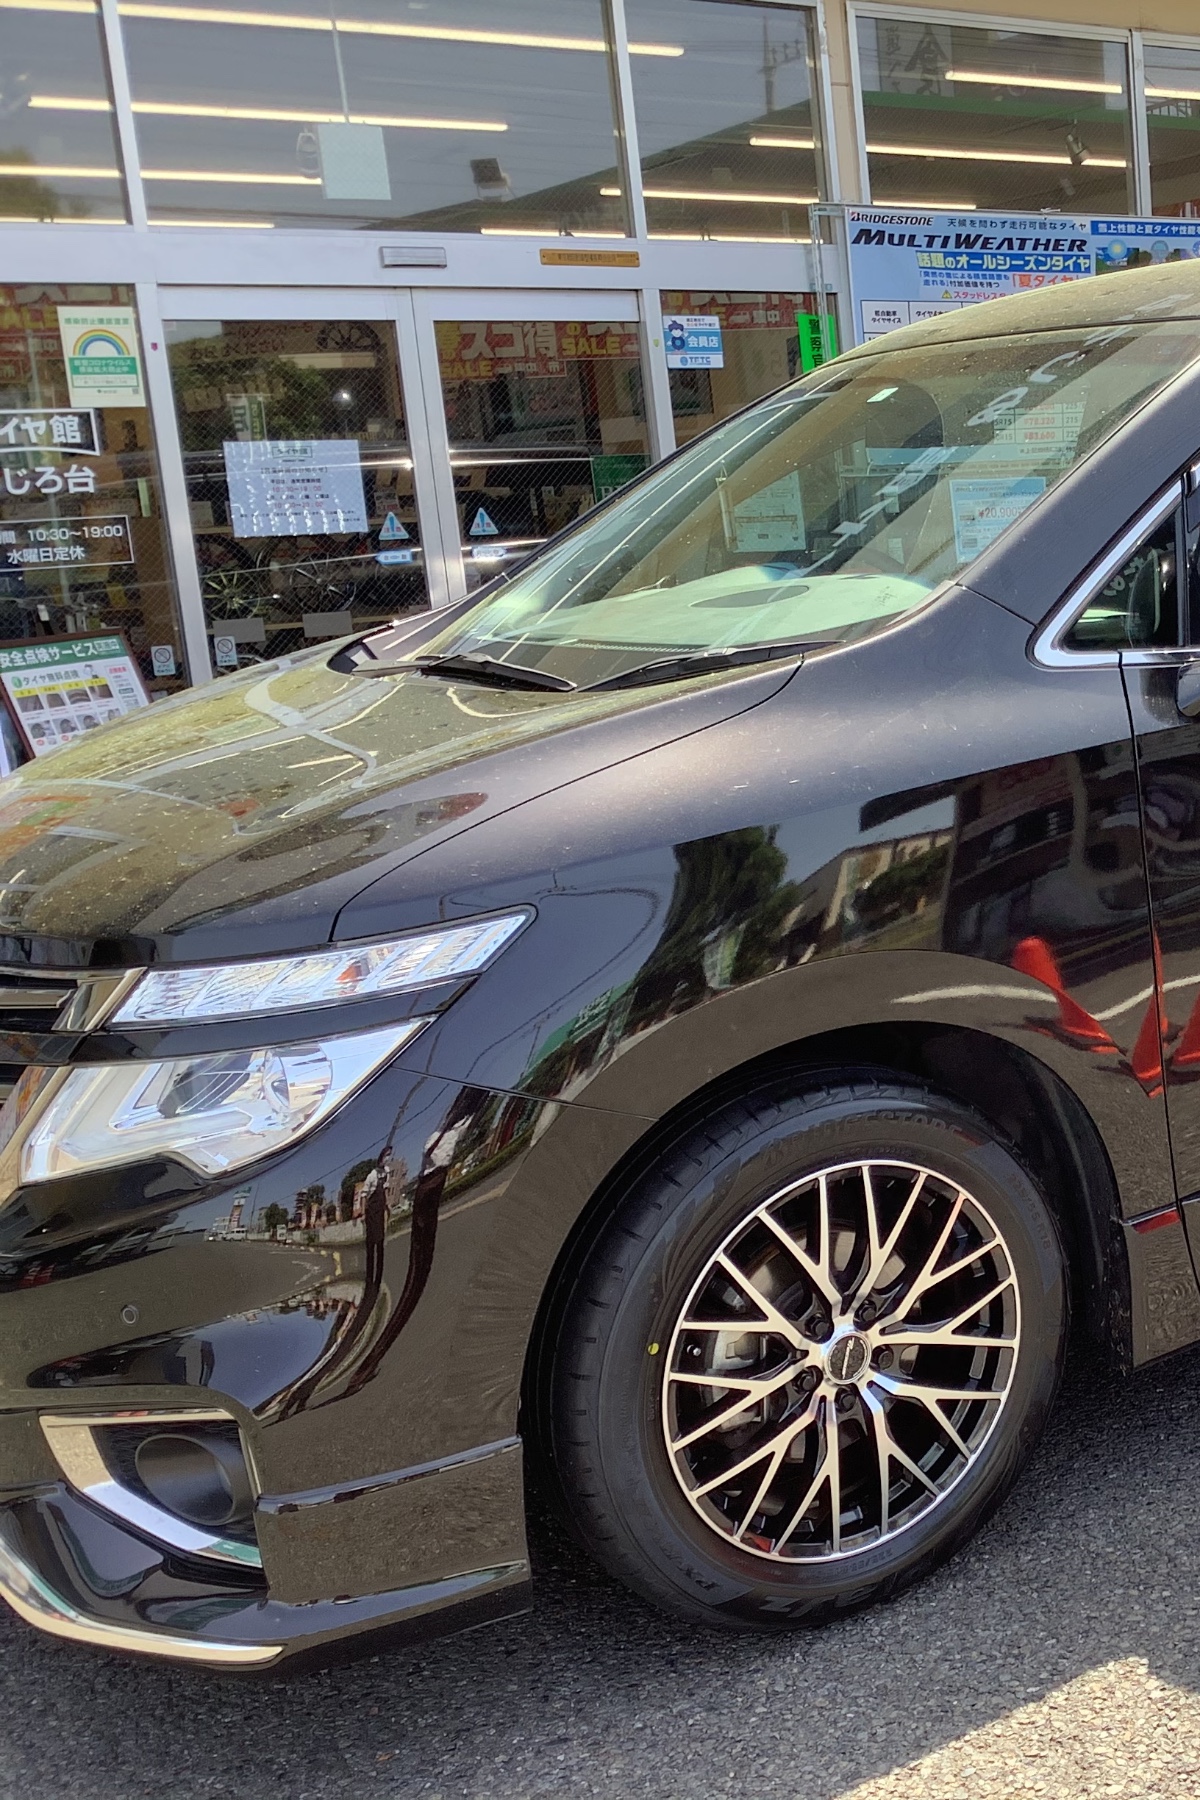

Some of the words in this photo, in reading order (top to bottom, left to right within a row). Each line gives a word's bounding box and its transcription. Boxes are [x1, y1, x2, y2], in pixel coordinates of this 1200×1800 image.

[850, 211, 934, 226] BRIDGESTONE
[946, 217, 1088, 231] 天候を問わず走行可能なタイヤ
[917, 251, 1091, 271] 話題のオールシーズンタイヤ
[561, 336, 622, 356] SALE
[688, 335, 719, 348] 会員店
[440, 360, 493, 377] SALE
[3, 464, 96, 495] じろ台
[7, 546, 86, 565] 水曜日定休
